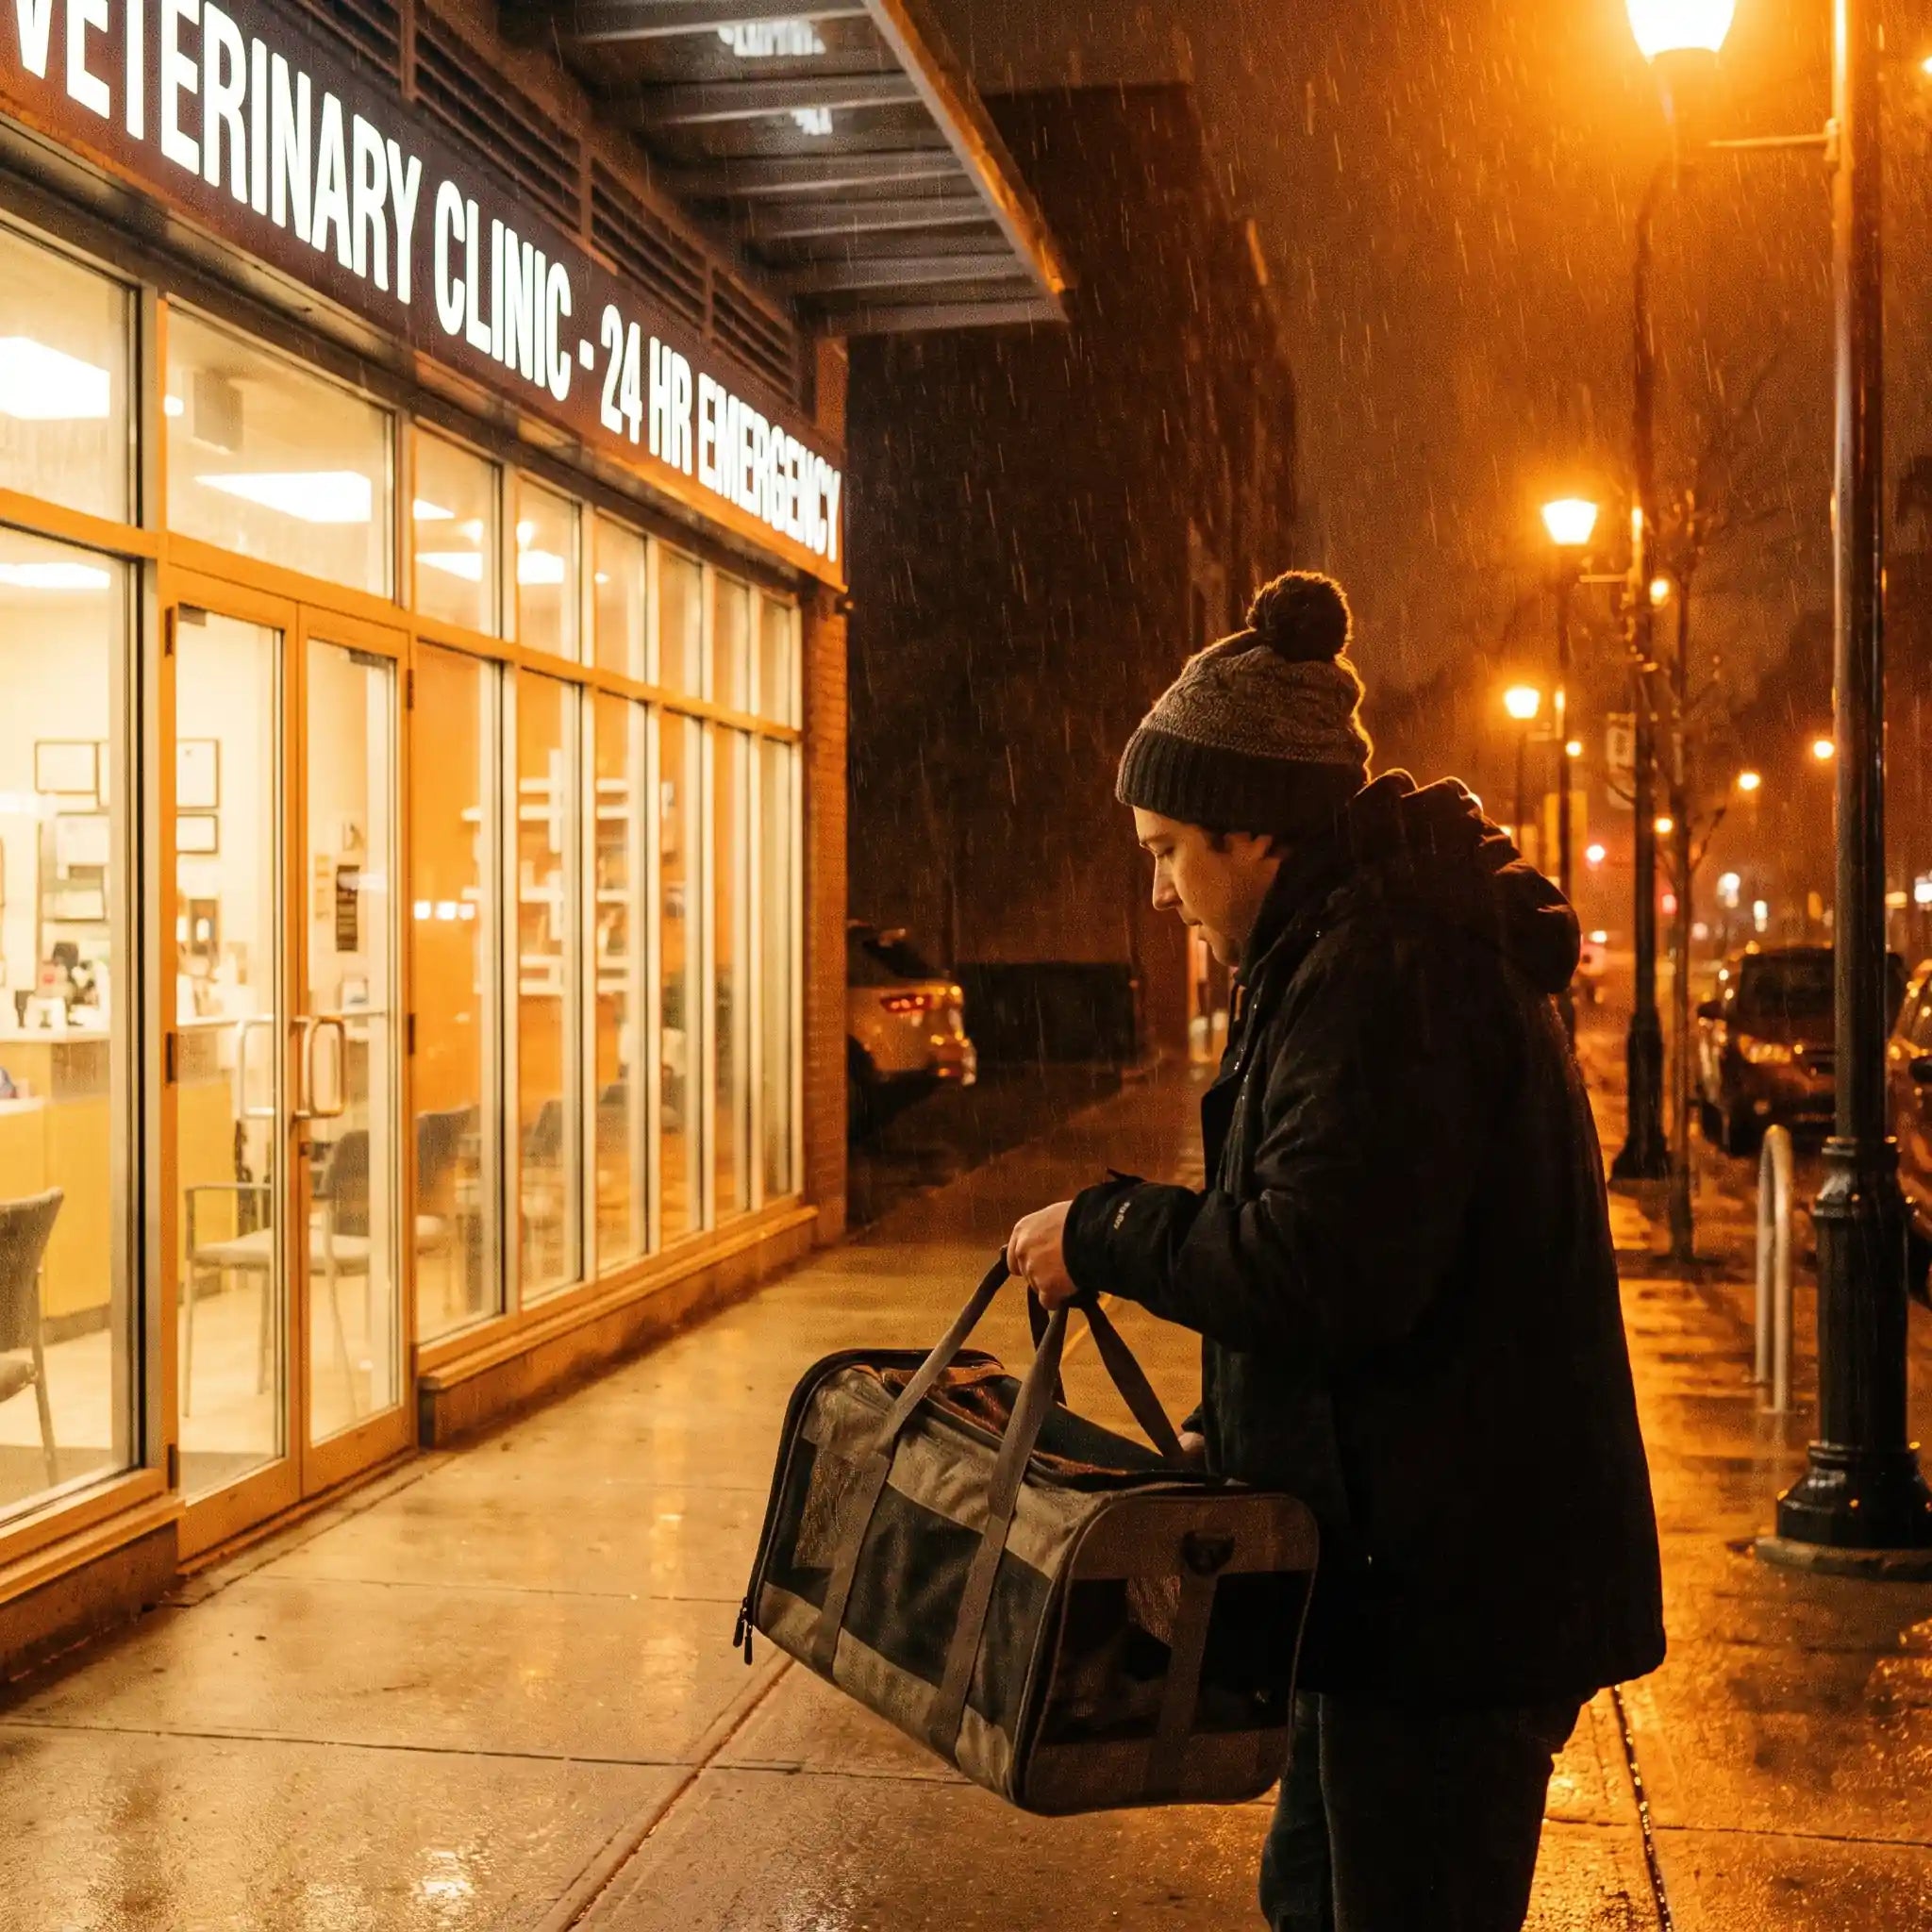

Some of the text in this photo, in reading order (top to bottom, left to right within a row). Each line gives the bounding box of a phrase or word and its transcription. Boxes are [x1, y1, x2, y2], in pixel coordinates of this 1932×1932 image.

[434, 180, 572, 402] CLINIC
[600, 304, 643, 444] 24
[649, 336, 692, 475] HR
[698, 372, 841, 562] EMERGENCY
